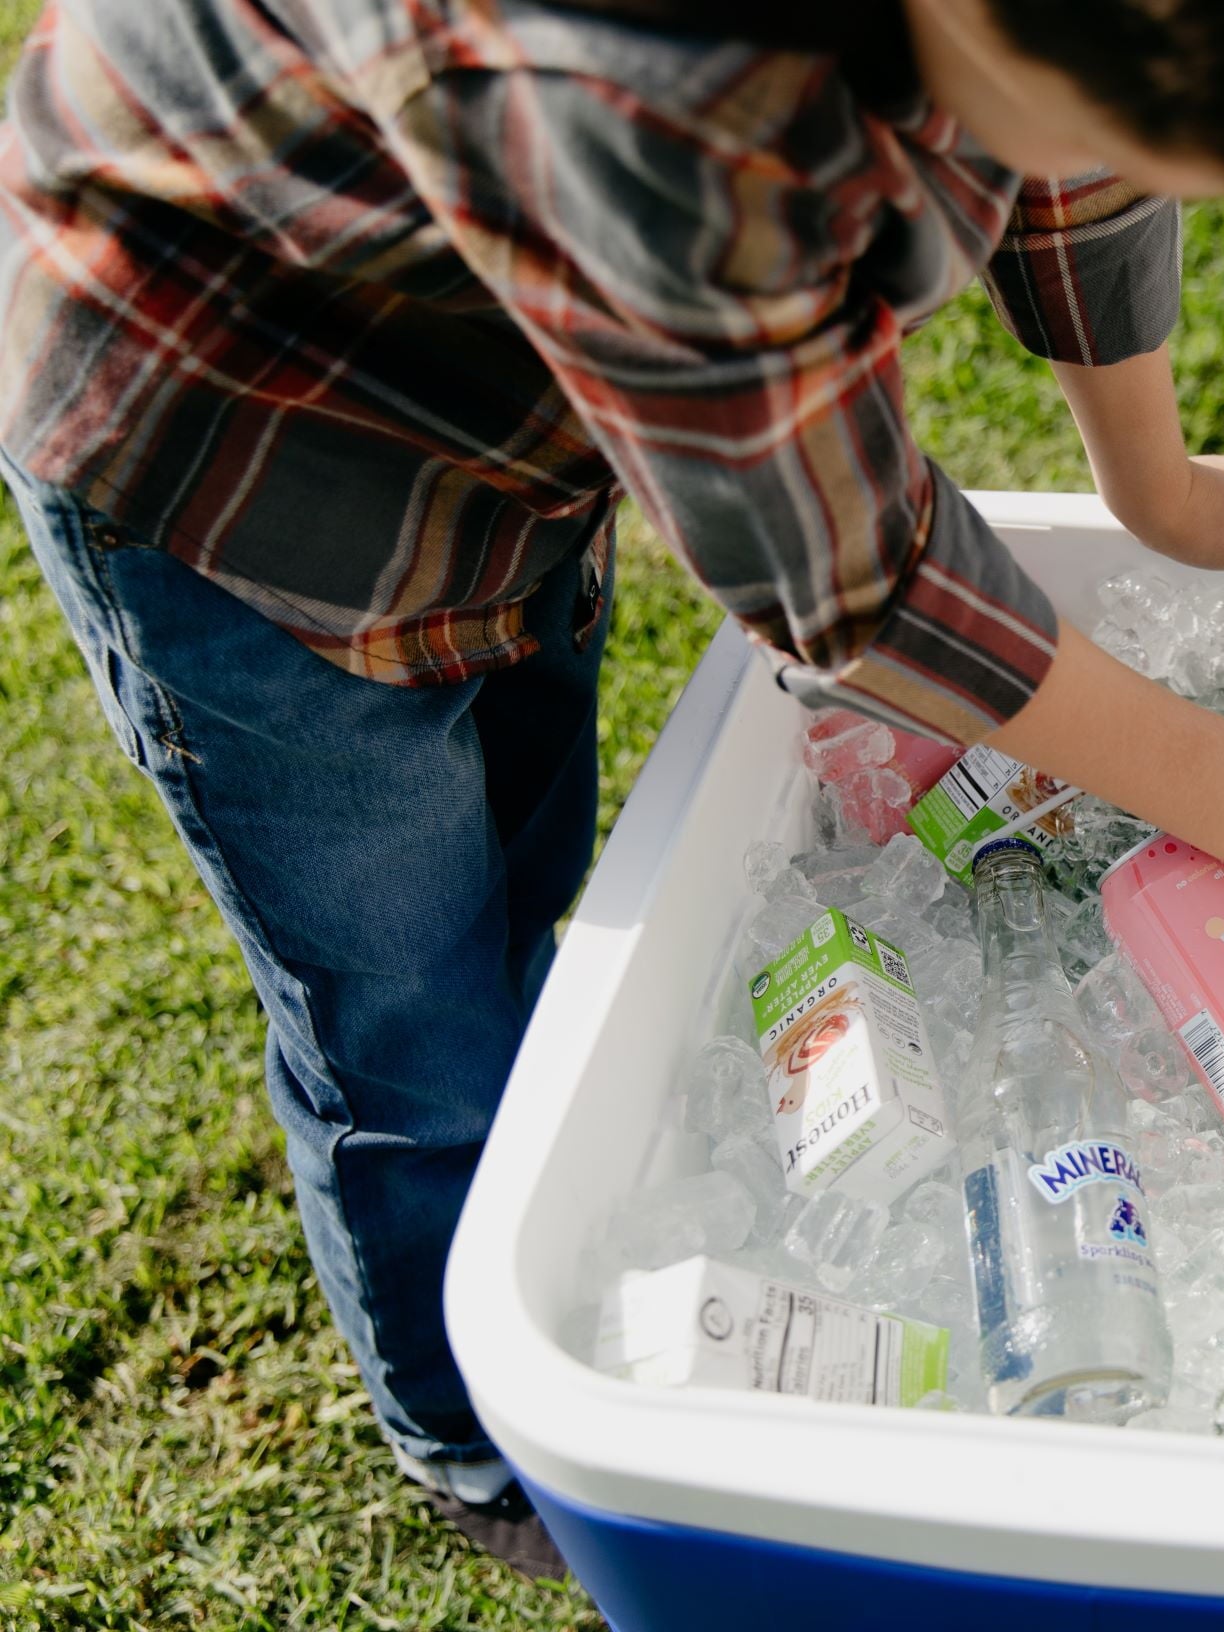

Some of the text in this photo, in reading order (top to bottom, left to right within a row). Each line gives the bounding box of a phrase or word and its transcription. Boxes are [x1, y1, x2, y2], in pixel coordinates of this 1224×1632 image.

[1002, 805, 1054, 848] ORANI
[1175, 879, 1188, 890] no
[817, 928, 830, 942] 35
[801, 953, 829, 981] EVER
[768, 977, 838, 1041] ORGANIC
[780, 973, 818, 1013] APPLEY
[785, 1083, 873, 1175] Honest
[843, 1119, 877, 1147] EVER
[830, 1136, 873, 1175] APPLEY
[798, 1295, 813, 1317] 35
[752, 1286, 777, 1389] Nutrition Facts
